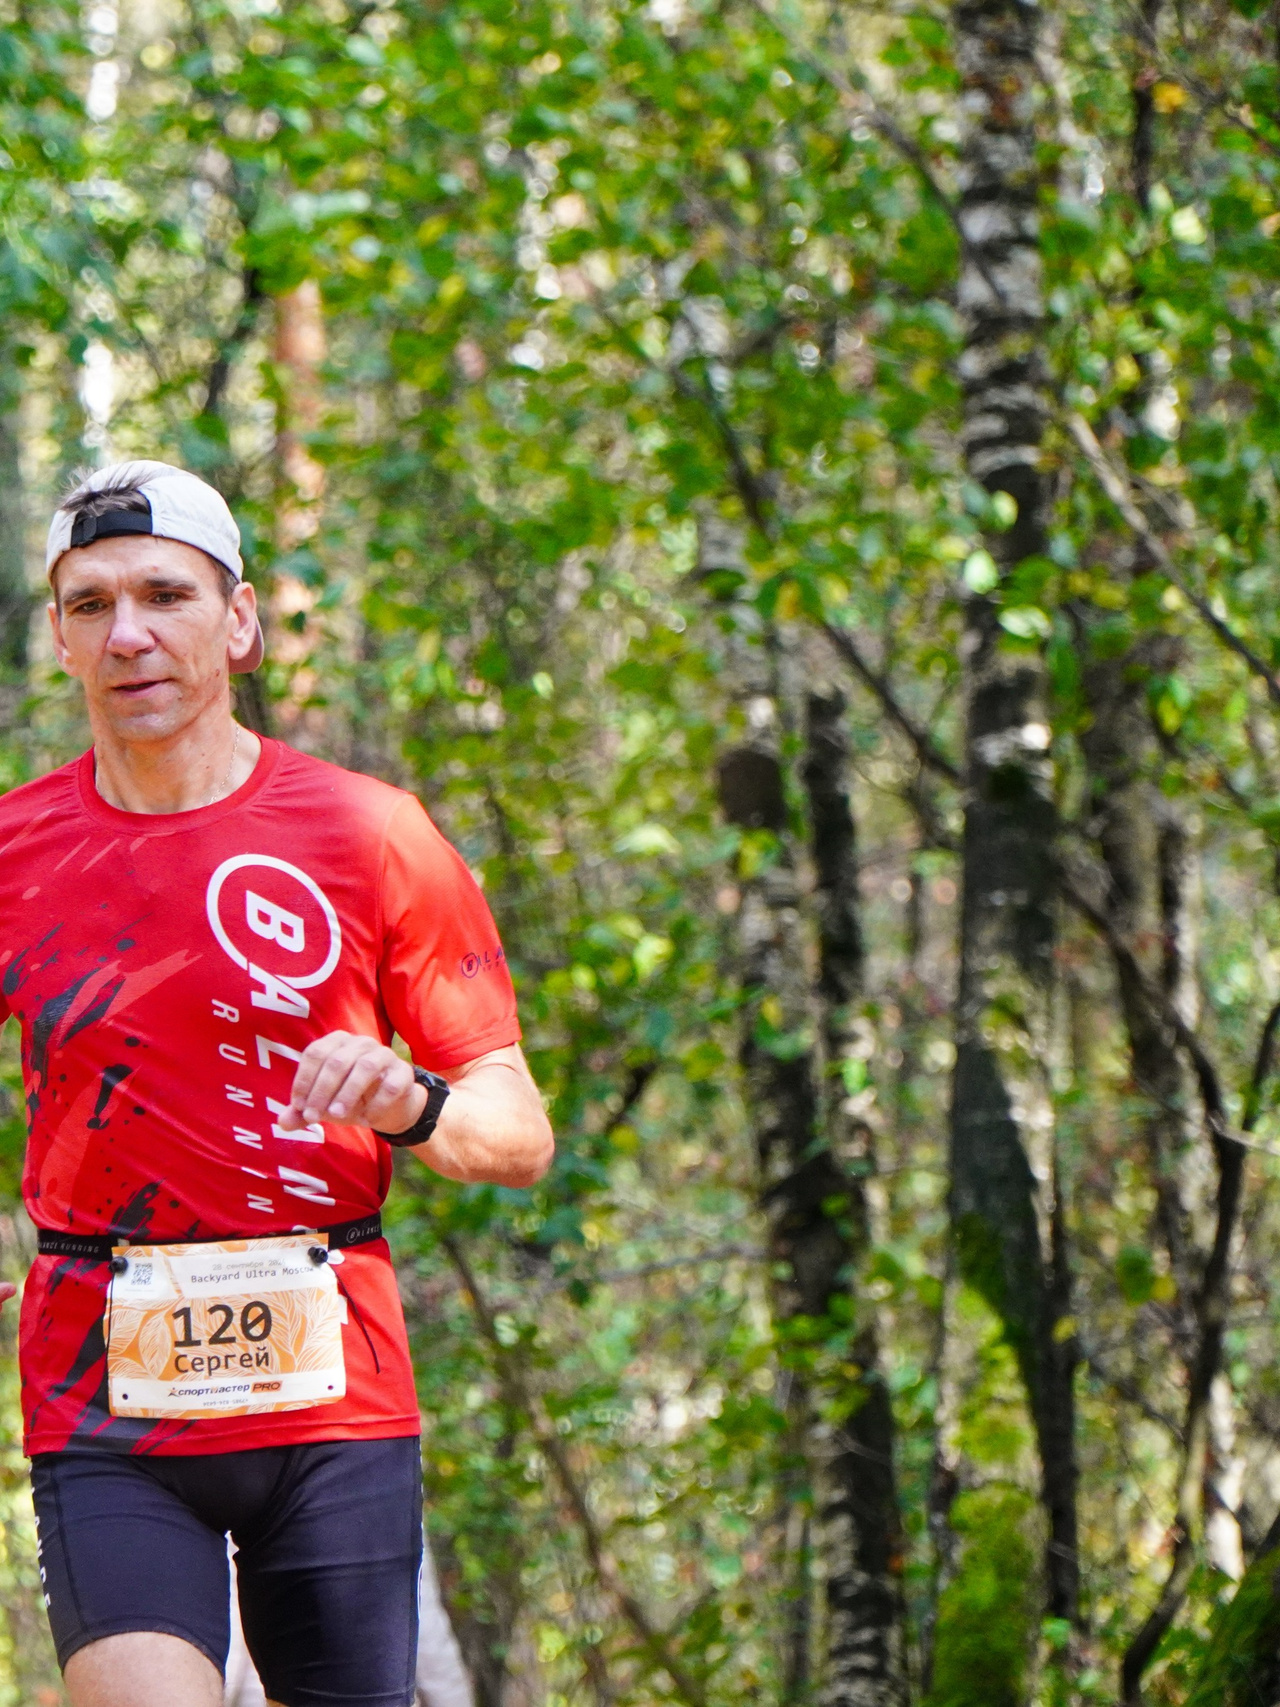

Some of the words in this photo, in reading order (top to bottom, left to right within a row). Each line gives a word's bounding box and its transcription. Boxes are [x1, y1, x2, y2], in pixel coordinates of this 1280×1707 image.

[211, 997, 276, 1214] RUNNIN
[191, 1270, 240, 1284] Backyard
[245, 1269, 277, 1279] Ultra
[282, 1266, 315, 1276] Moscow
[172, 1300, 273, 1348] 120
[174, 1347, 270, 1376] Сергей
[177, 1384, 250, 1397] спортмастер
[252, 1382, 282, 1392] PRO
